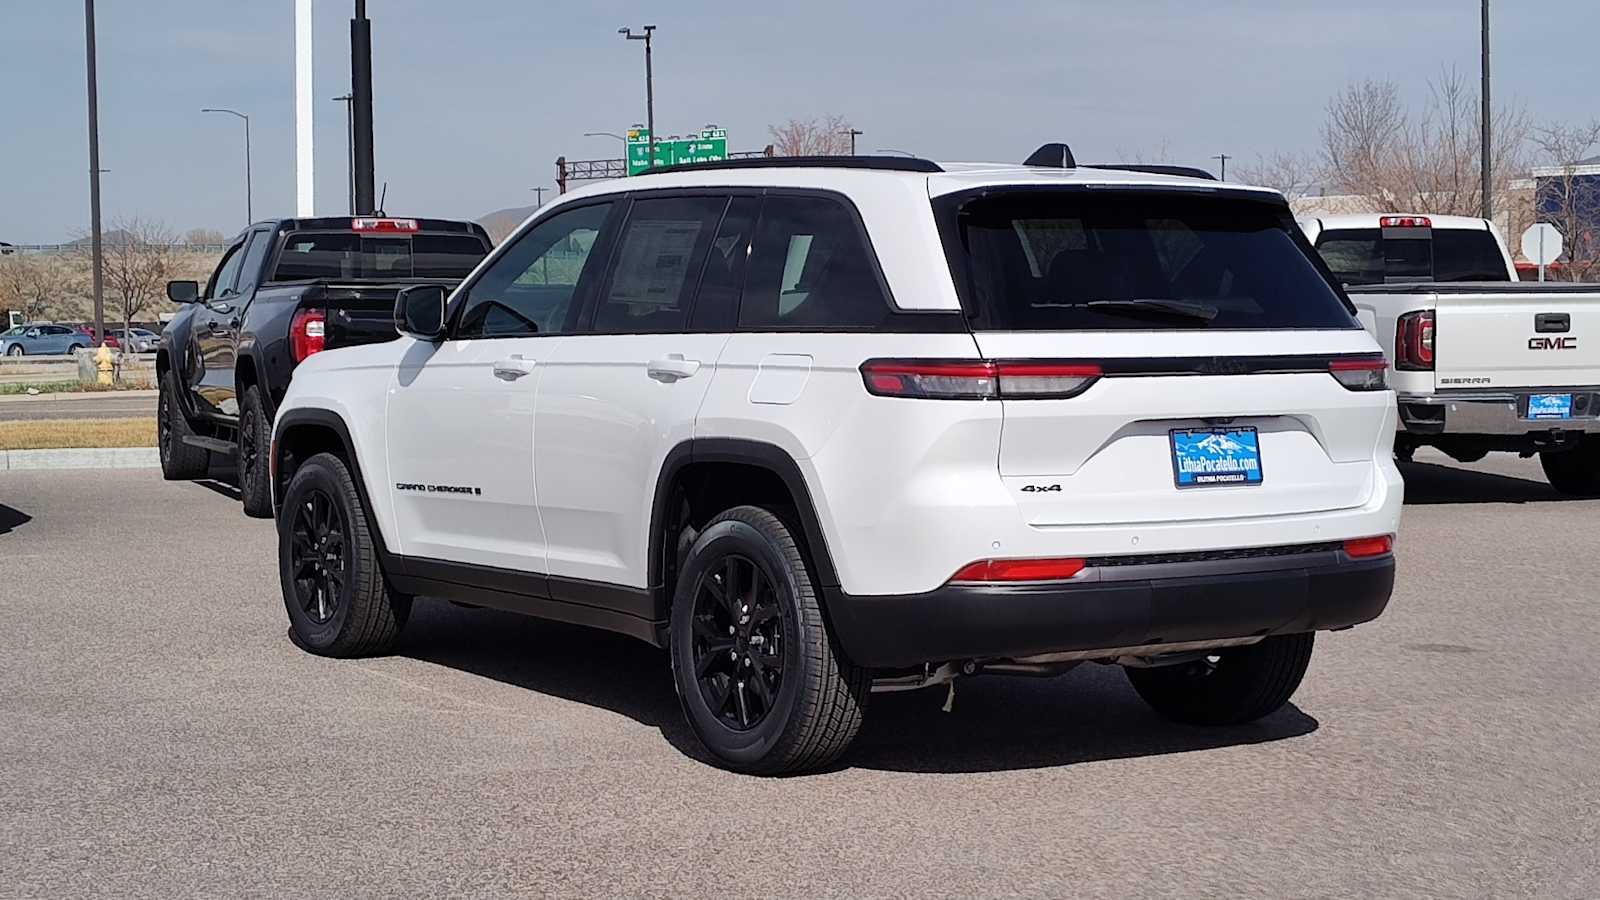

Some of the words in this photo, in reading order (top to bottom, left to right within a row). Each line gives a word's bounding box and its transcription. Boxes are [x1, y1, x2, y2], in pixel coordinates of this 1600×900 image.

[1528, 337, 1577, 350] GMC
[1178, 455, 1258, 473] LithiaPocatello.com
[396, 483, 426, 491] GRAND
[427, 485, 473, 494] CHEROKEE
[1020, 484, 1063, 492] 4x4
